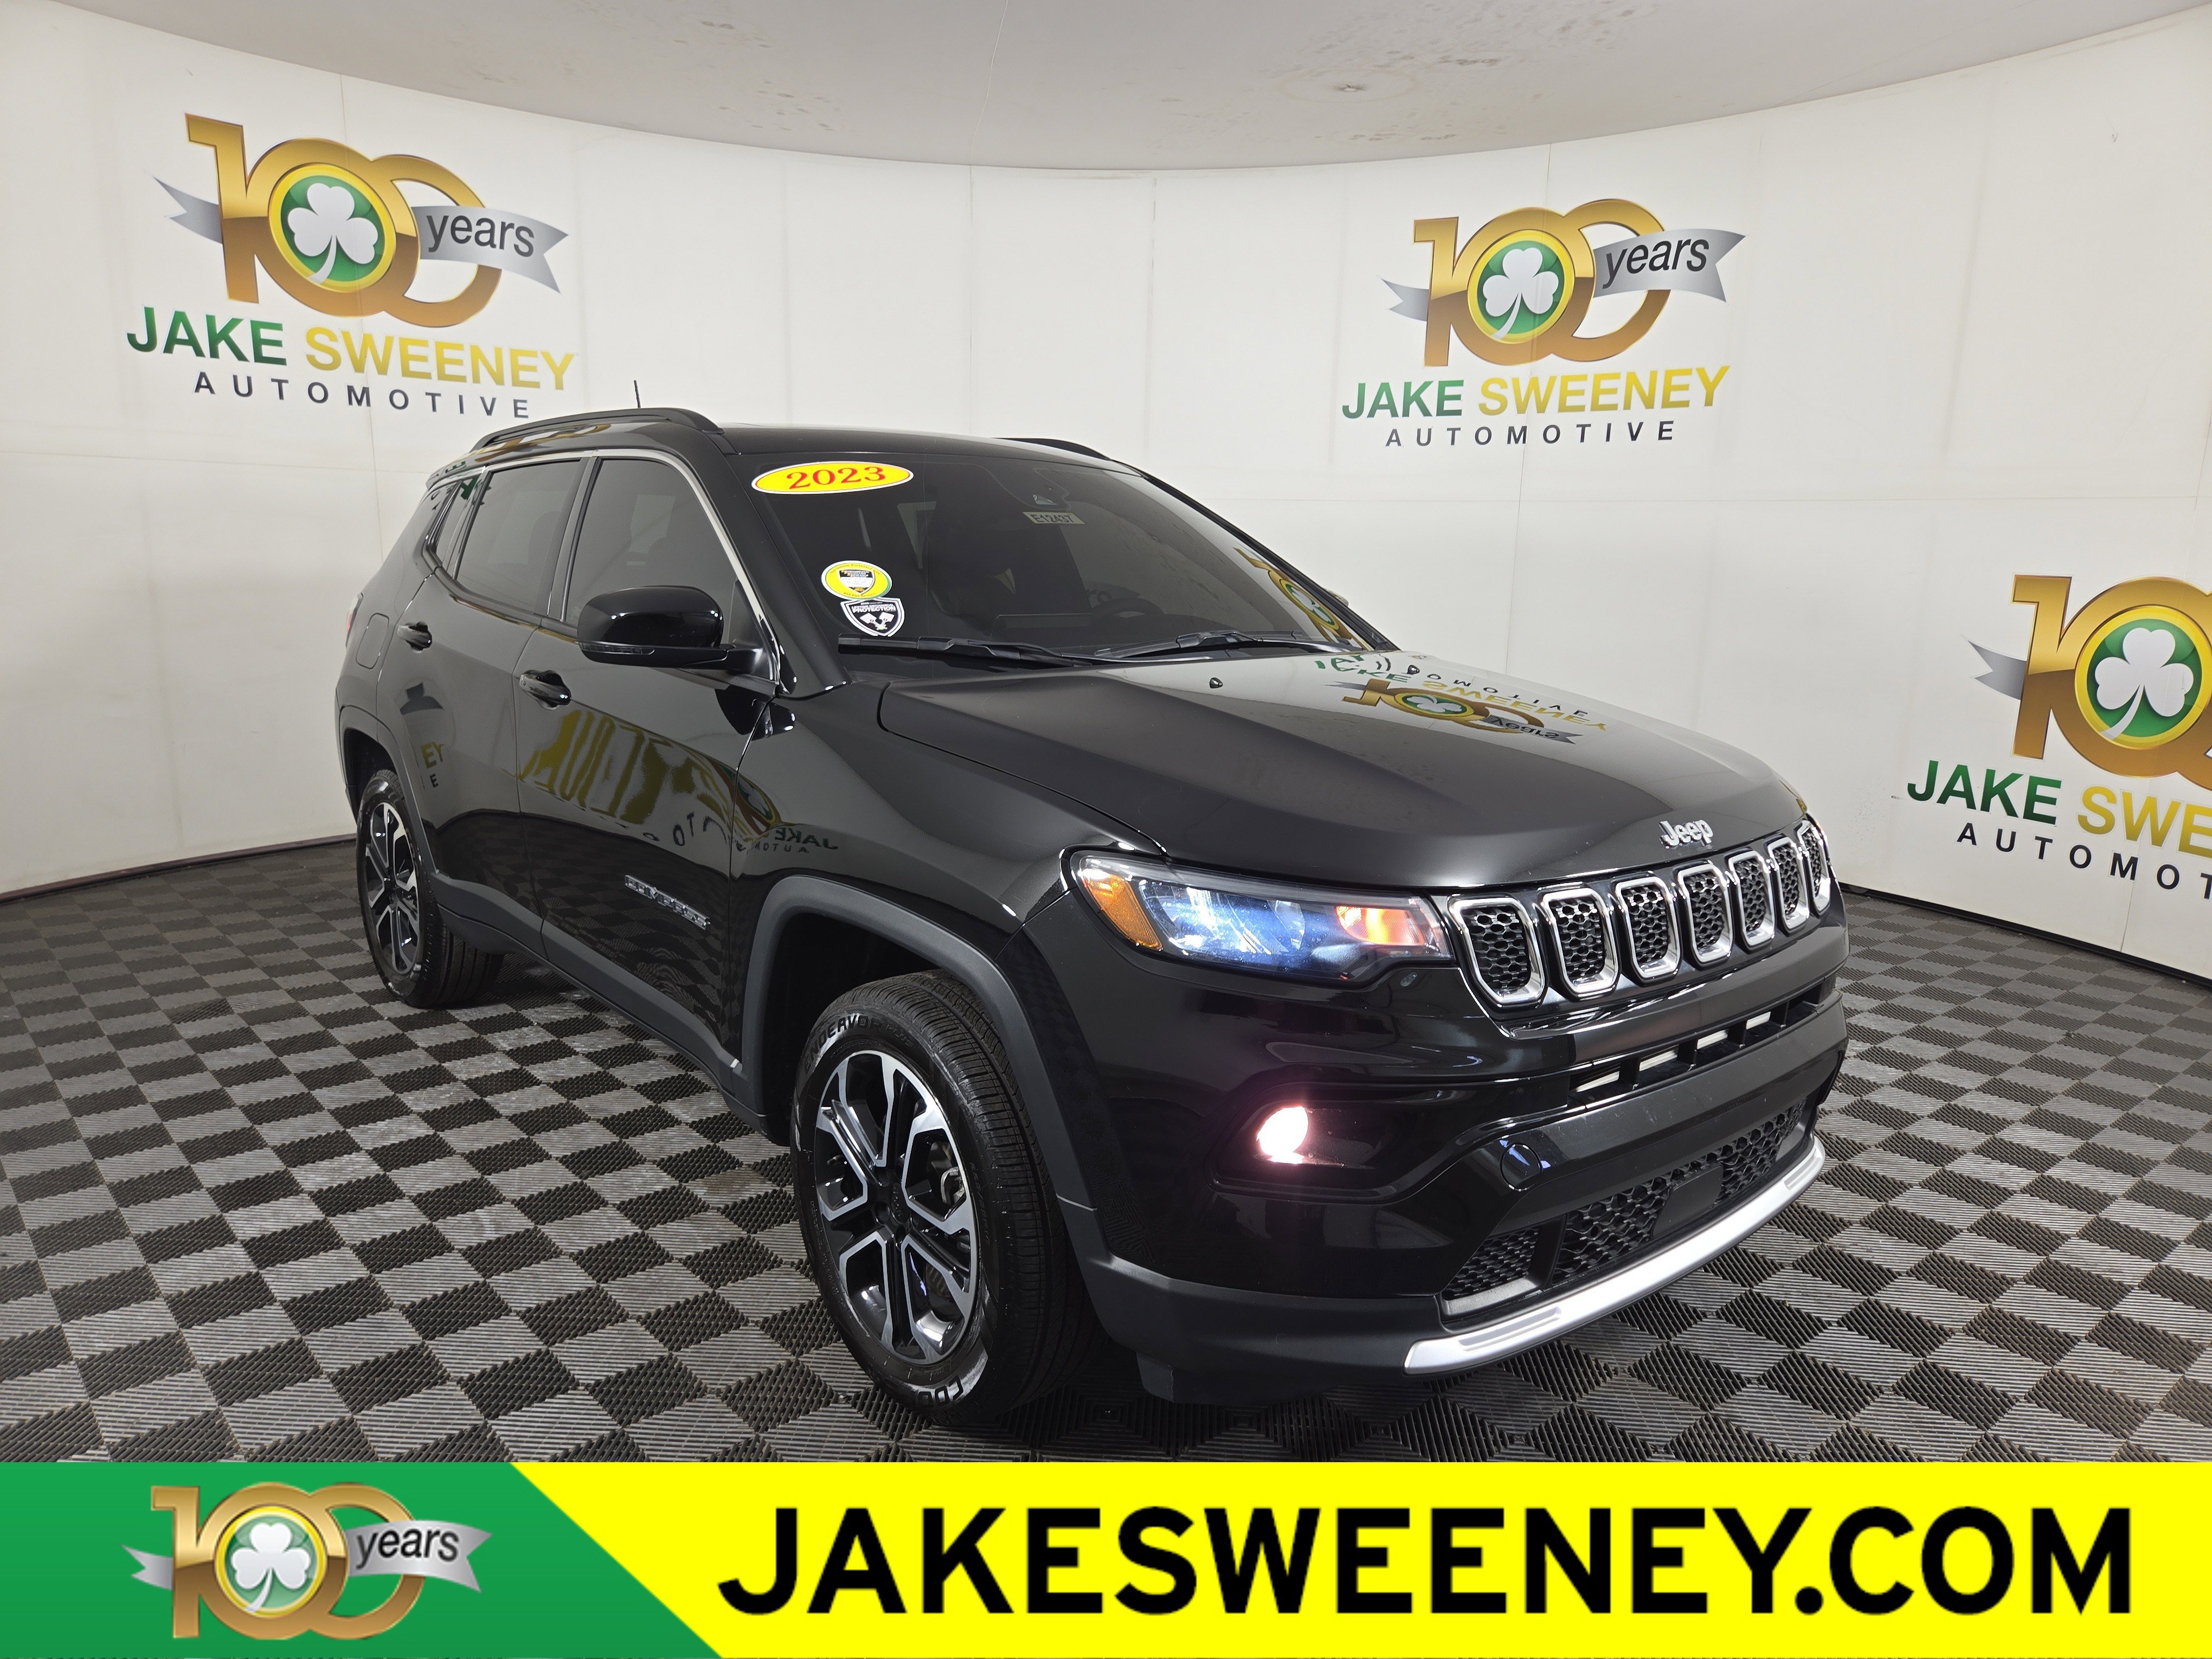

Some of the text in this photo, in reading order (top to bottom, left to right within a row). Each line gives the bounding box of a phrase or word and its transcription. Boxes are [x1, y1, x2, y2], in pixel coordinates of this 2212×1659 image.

[185, 113, 503, 327] 100
[426, 215, 535, 258] years
[1413, 198, 1670, 367] 100
[1602, 239, 1709, 290] years
[126, 306, 575, 391] JAKE SWEENEY
[194, 371, 530, 419] AUTOMOTIVE
[1342, 365, 1731, 419] JAKE SWEENEY
[1385, 420, 1675, 447] AUTOMOTIVE
[787, 466, 886, 490] 2023
[1907, 760, 2062, 825] JAKE
[1659, 819, 1713, 847] Jeep
